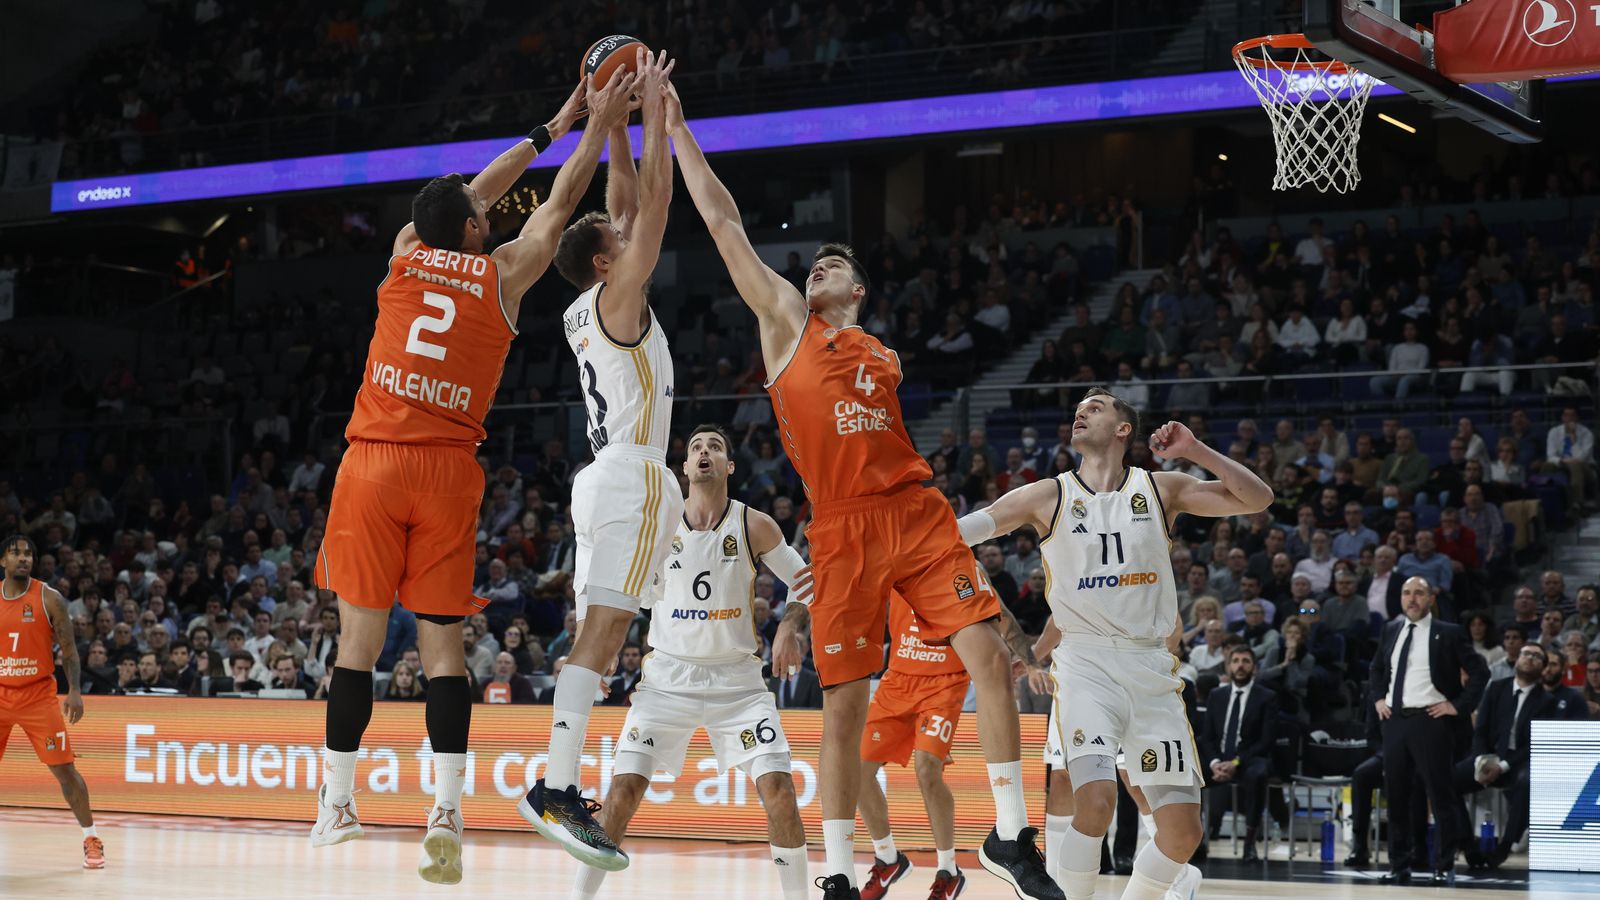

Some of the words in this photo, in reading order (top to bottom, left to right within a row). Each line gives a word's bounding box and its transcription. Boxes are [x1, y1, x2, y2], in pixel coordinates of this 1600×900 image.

[409, 249, 487, 276] PUERTO
[405, 290, 456, 361] 2
[372, 361, 472, 412] VALENCIA
[855, 363, 875, 396] 4
[1097, 531, 1125, 565] 11
[692, 570, 712, 601] 6
[976, 566, 994, 598] 4
[1077, 571, 1158, 591] AUTOHERO
[671, 607, 742, 621] AUTOHERO
[8, 632, 19, 653] 7
[56, 731, 66, 751] 7
[755, 717, 777, 744] 6
[926, 715, 952, 743] 30
[125, 724, 399, 794] Encuena
[1160, 740, 1185, 772] 11
